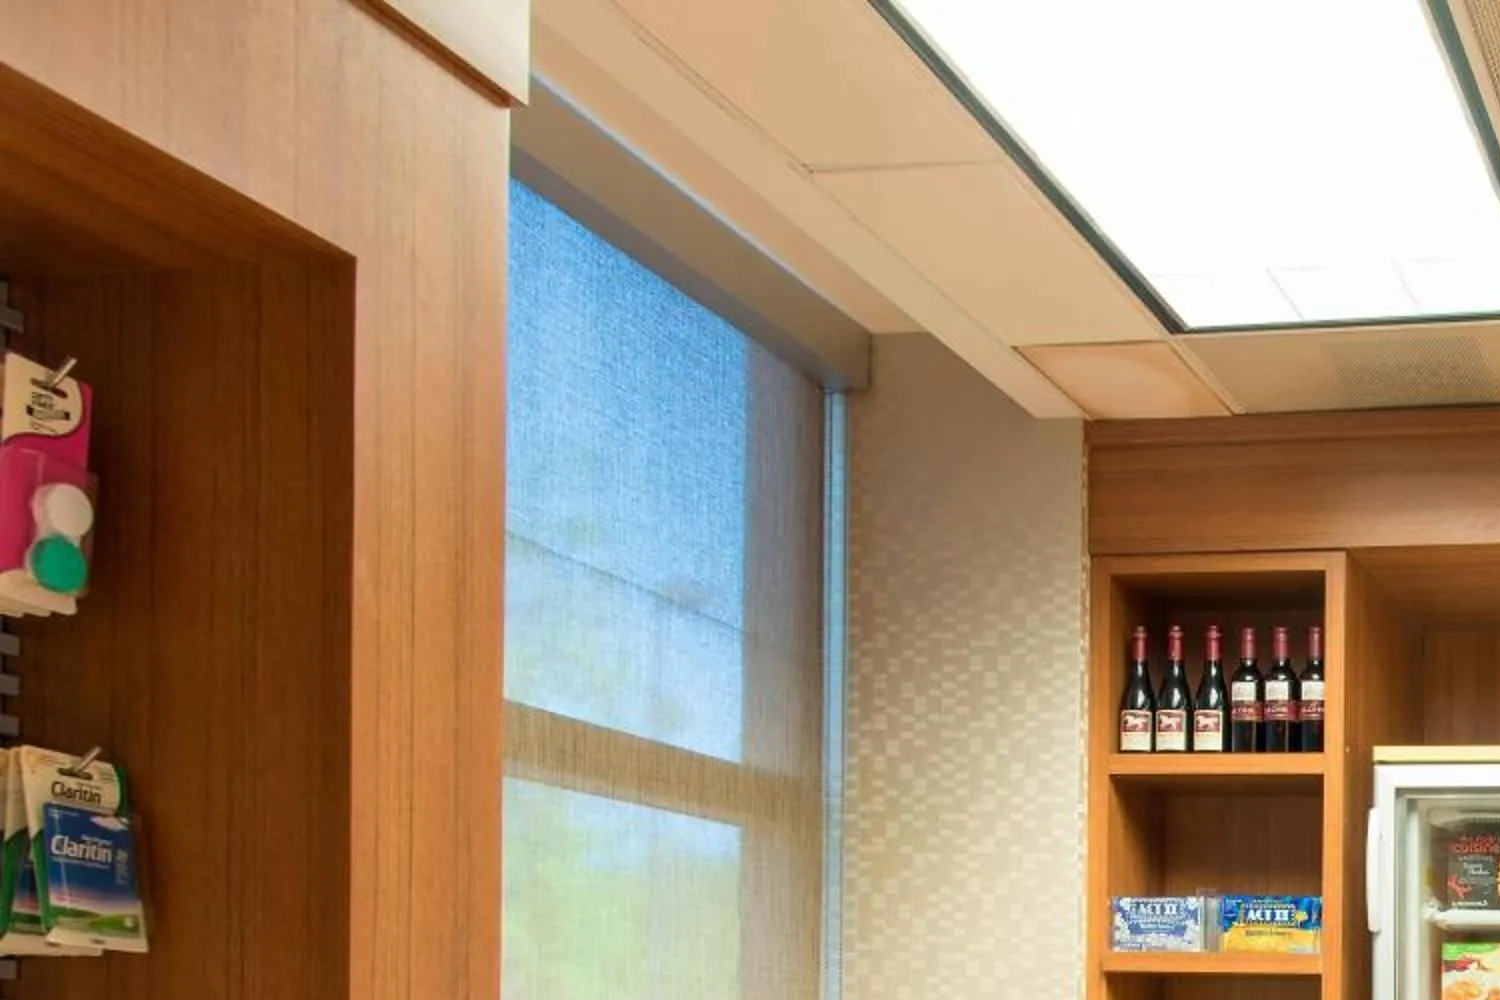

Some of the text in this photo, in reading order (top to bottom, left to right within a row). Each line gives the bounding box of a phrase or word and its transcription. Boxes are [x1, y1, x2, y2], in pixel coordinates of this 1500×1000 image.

[51, 780, 103, 804] Claritin
[51, 834, 113, 863] Claritin
[1247, 909, 1289, 921] ACT II
